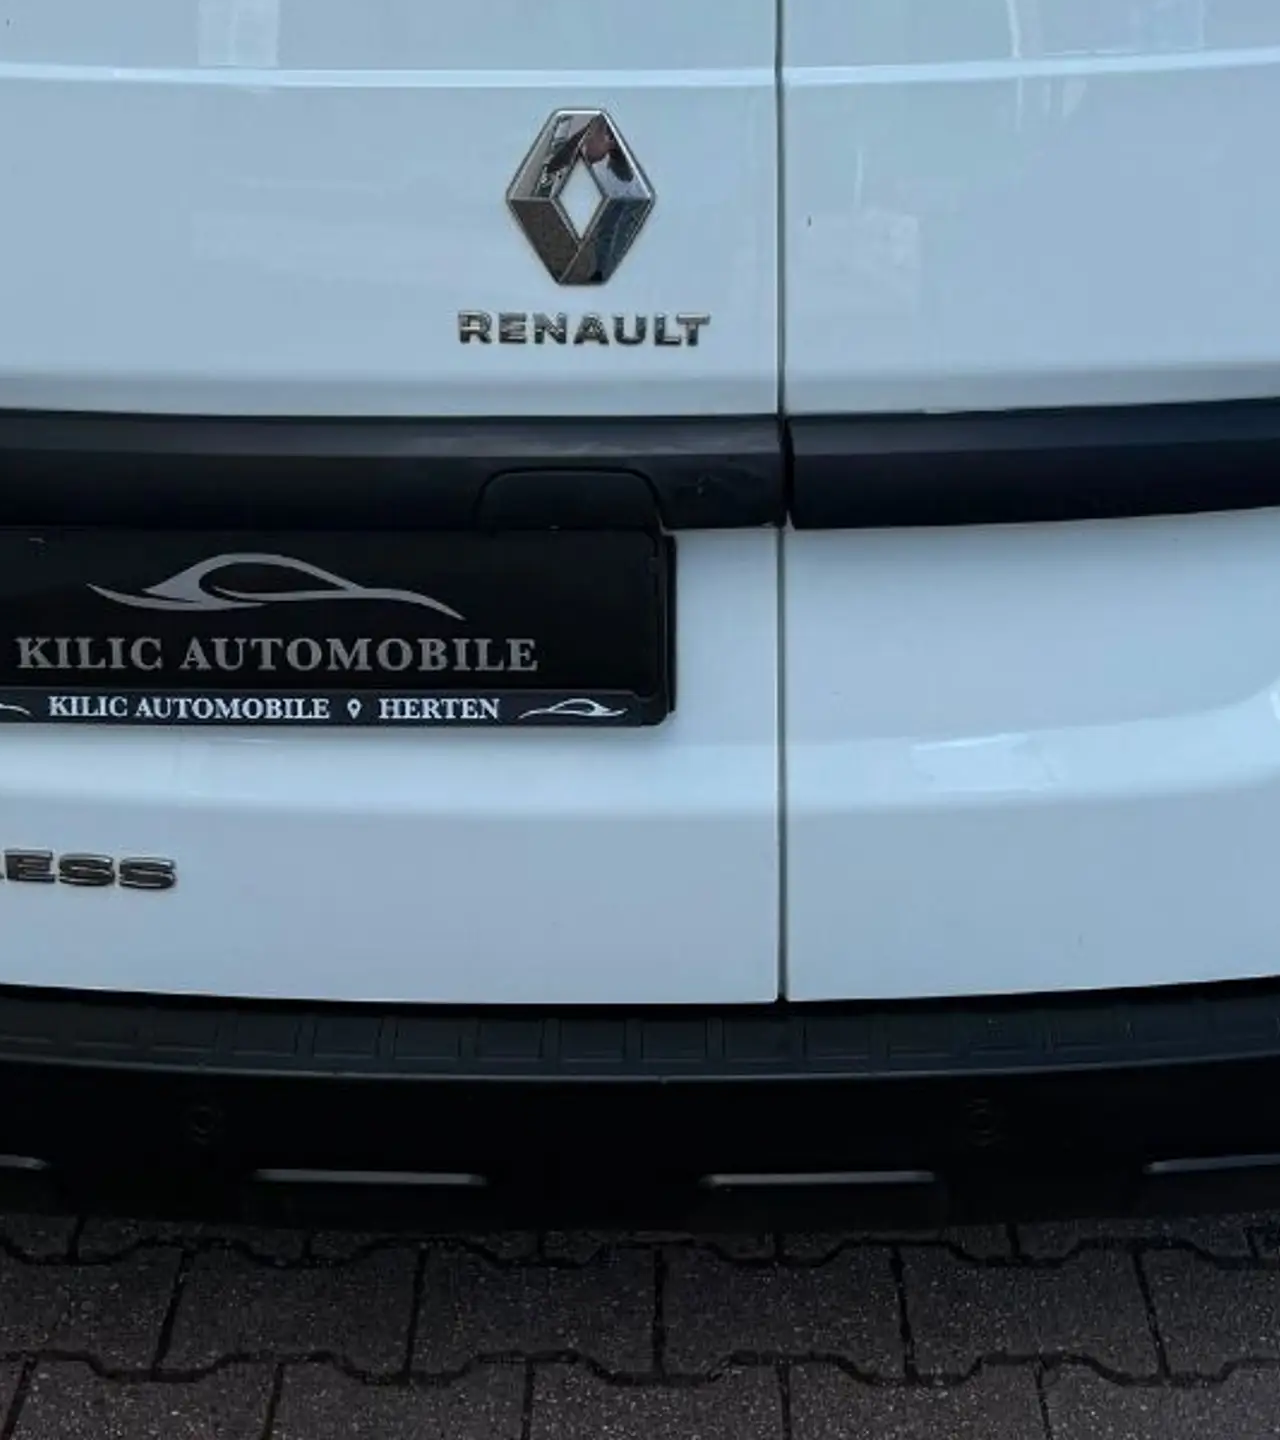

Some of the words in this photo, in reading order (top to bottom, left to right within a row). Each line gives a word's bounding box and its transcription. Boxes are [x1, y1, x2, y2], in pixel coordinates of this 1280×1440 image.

[458, 311, 711, 347] RENAULT
[15, 636, 163, 671] KILIC
[179, 636, 538, 672] AUTOMOBILE
[48, 695, 128, 717] KILIC
[134, 697, 330, 720] AUTOMOBILE
[378, 697, 500, 720] HERTEN
